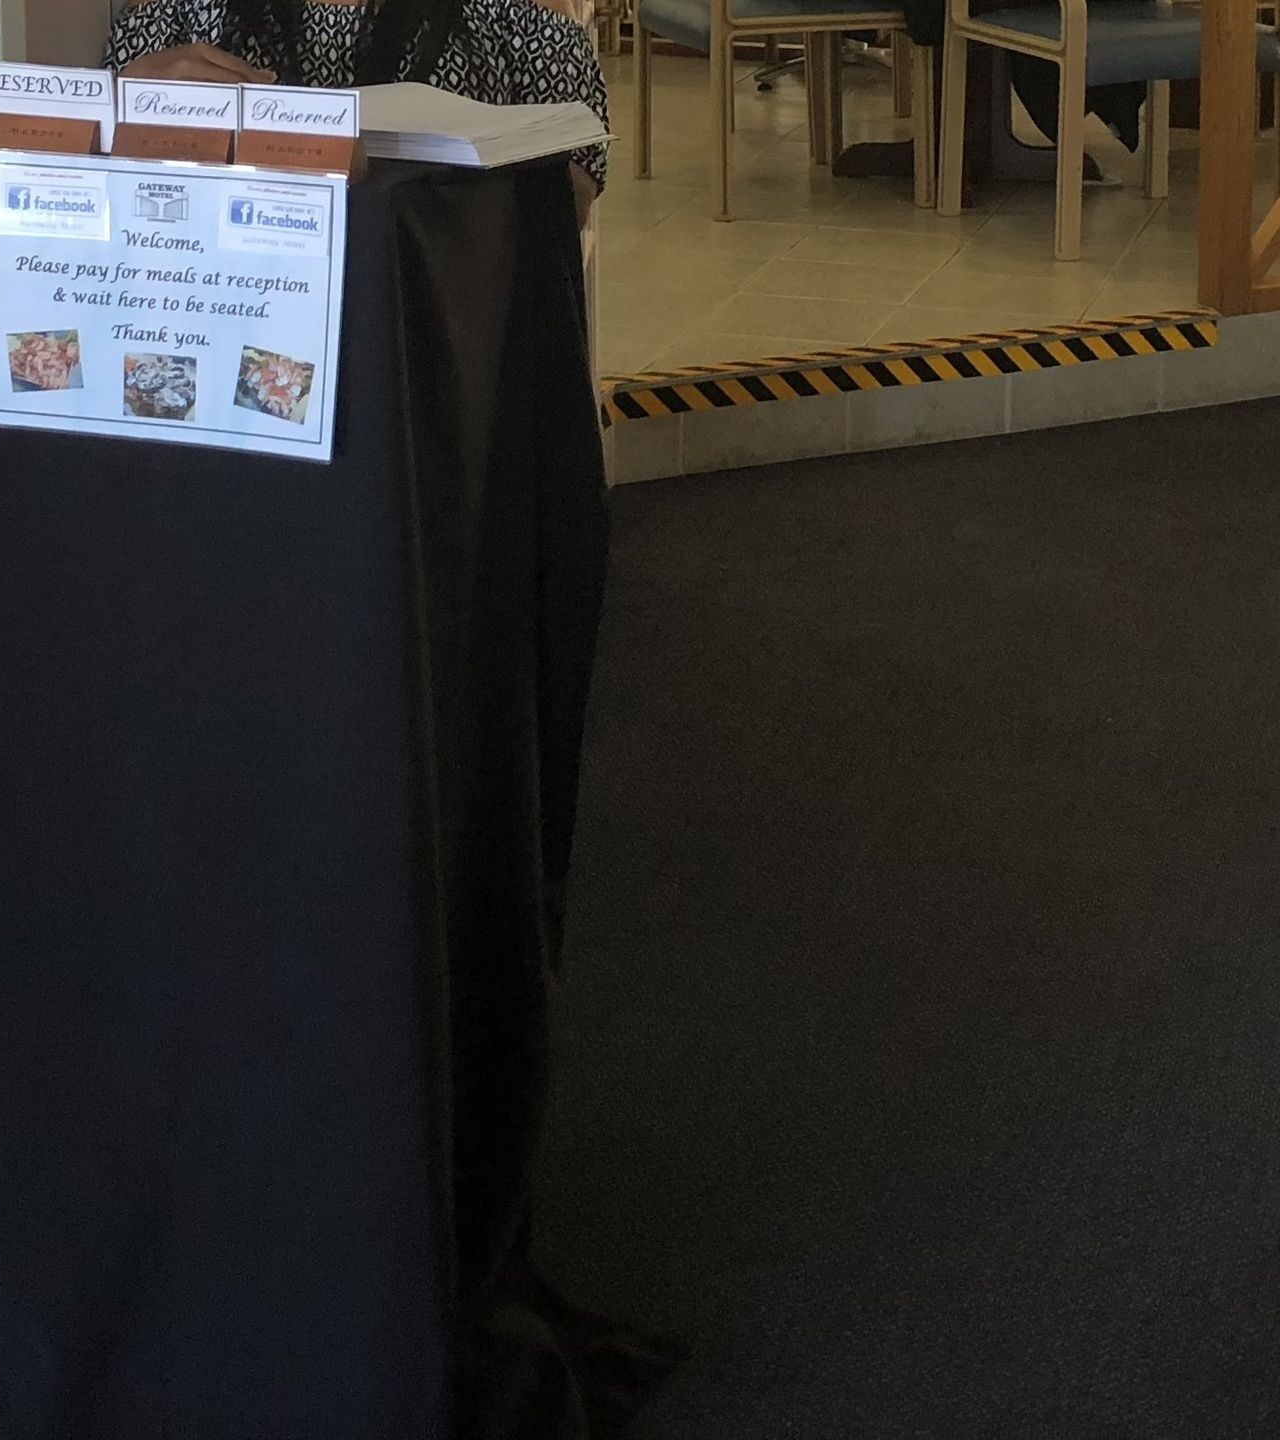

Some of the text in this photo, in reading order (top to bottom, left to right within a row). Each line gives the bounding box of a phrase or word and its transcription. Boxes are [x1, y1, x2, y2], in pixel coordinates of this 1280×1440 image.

[134, 90, 232, 119] Reserved
[251, 97, 348, 126] Reserved
[138, 182, 186, 193] GATEWAY
[148, 191, 175, 200] MOTEL
[34, 196, 96, 213] facebook
[256, 210, 319, 232] facebook
[121, 229, 205, 254] Welcome,
[16, 255, 311, 295] Please pay for meals at reception
[53, 287, 271, 319] & wait here to be seated.
[111, 324, 211, 350] Thank you.
